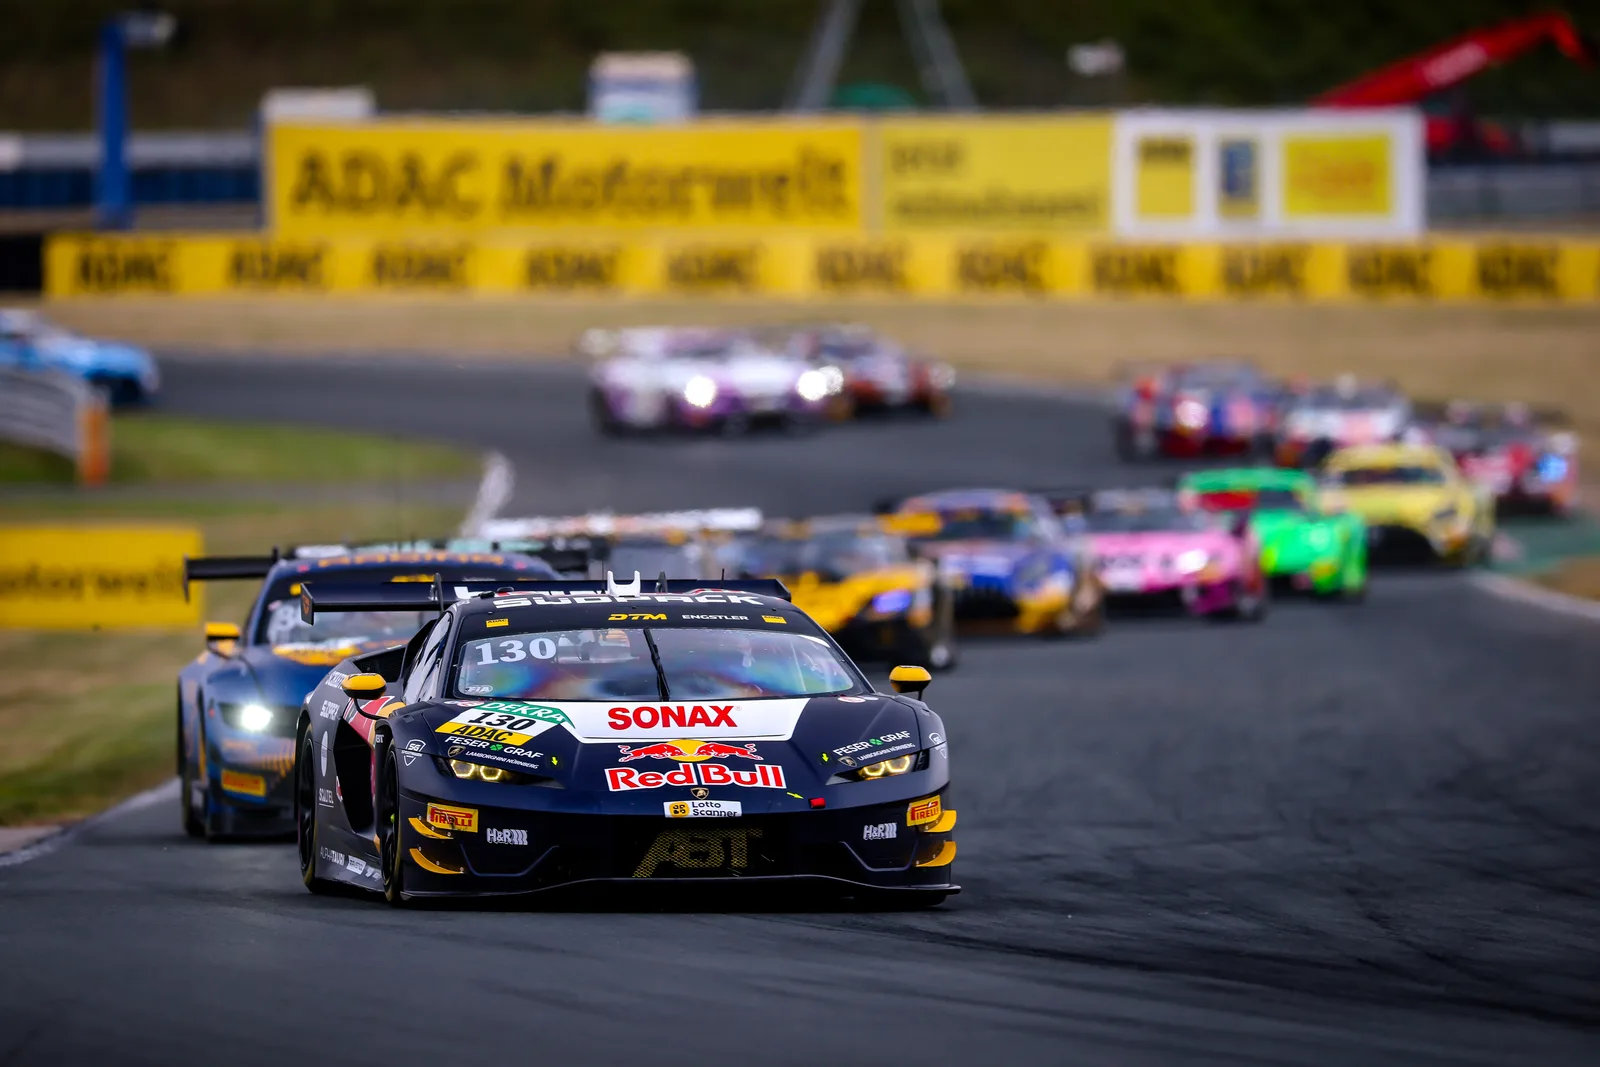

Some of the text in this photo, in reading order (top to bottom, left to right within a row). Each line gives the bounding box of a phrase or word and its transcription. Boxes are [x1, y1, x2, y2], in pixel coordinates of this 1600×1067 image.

[293, 149, 484, 219] ADAC
[608, 613, 667, 621] DTM
[475, 638, 557, 665] 130
[468, 712, 537, 731] 130
[483, 702, 566, 722] DEKRA
[608, 706, 738, 730] SONAX
[451, 725, 514, 742] ADAC
[832, 730, 911, 756] FESER GRAF
[444, 735, 544, 759] FESER GRAF
[605, 763, 786, 791] Red Bull
[692, 801, 721, 809] Lotto
[692, 809, 738, 818] Scanner
[910, 800, 939, 821] PIRELLI
[429, 806, 473, 828] PIRELLI
[486, 828, 513, 844] H&R
[632, 829, 763, 878] ABT
